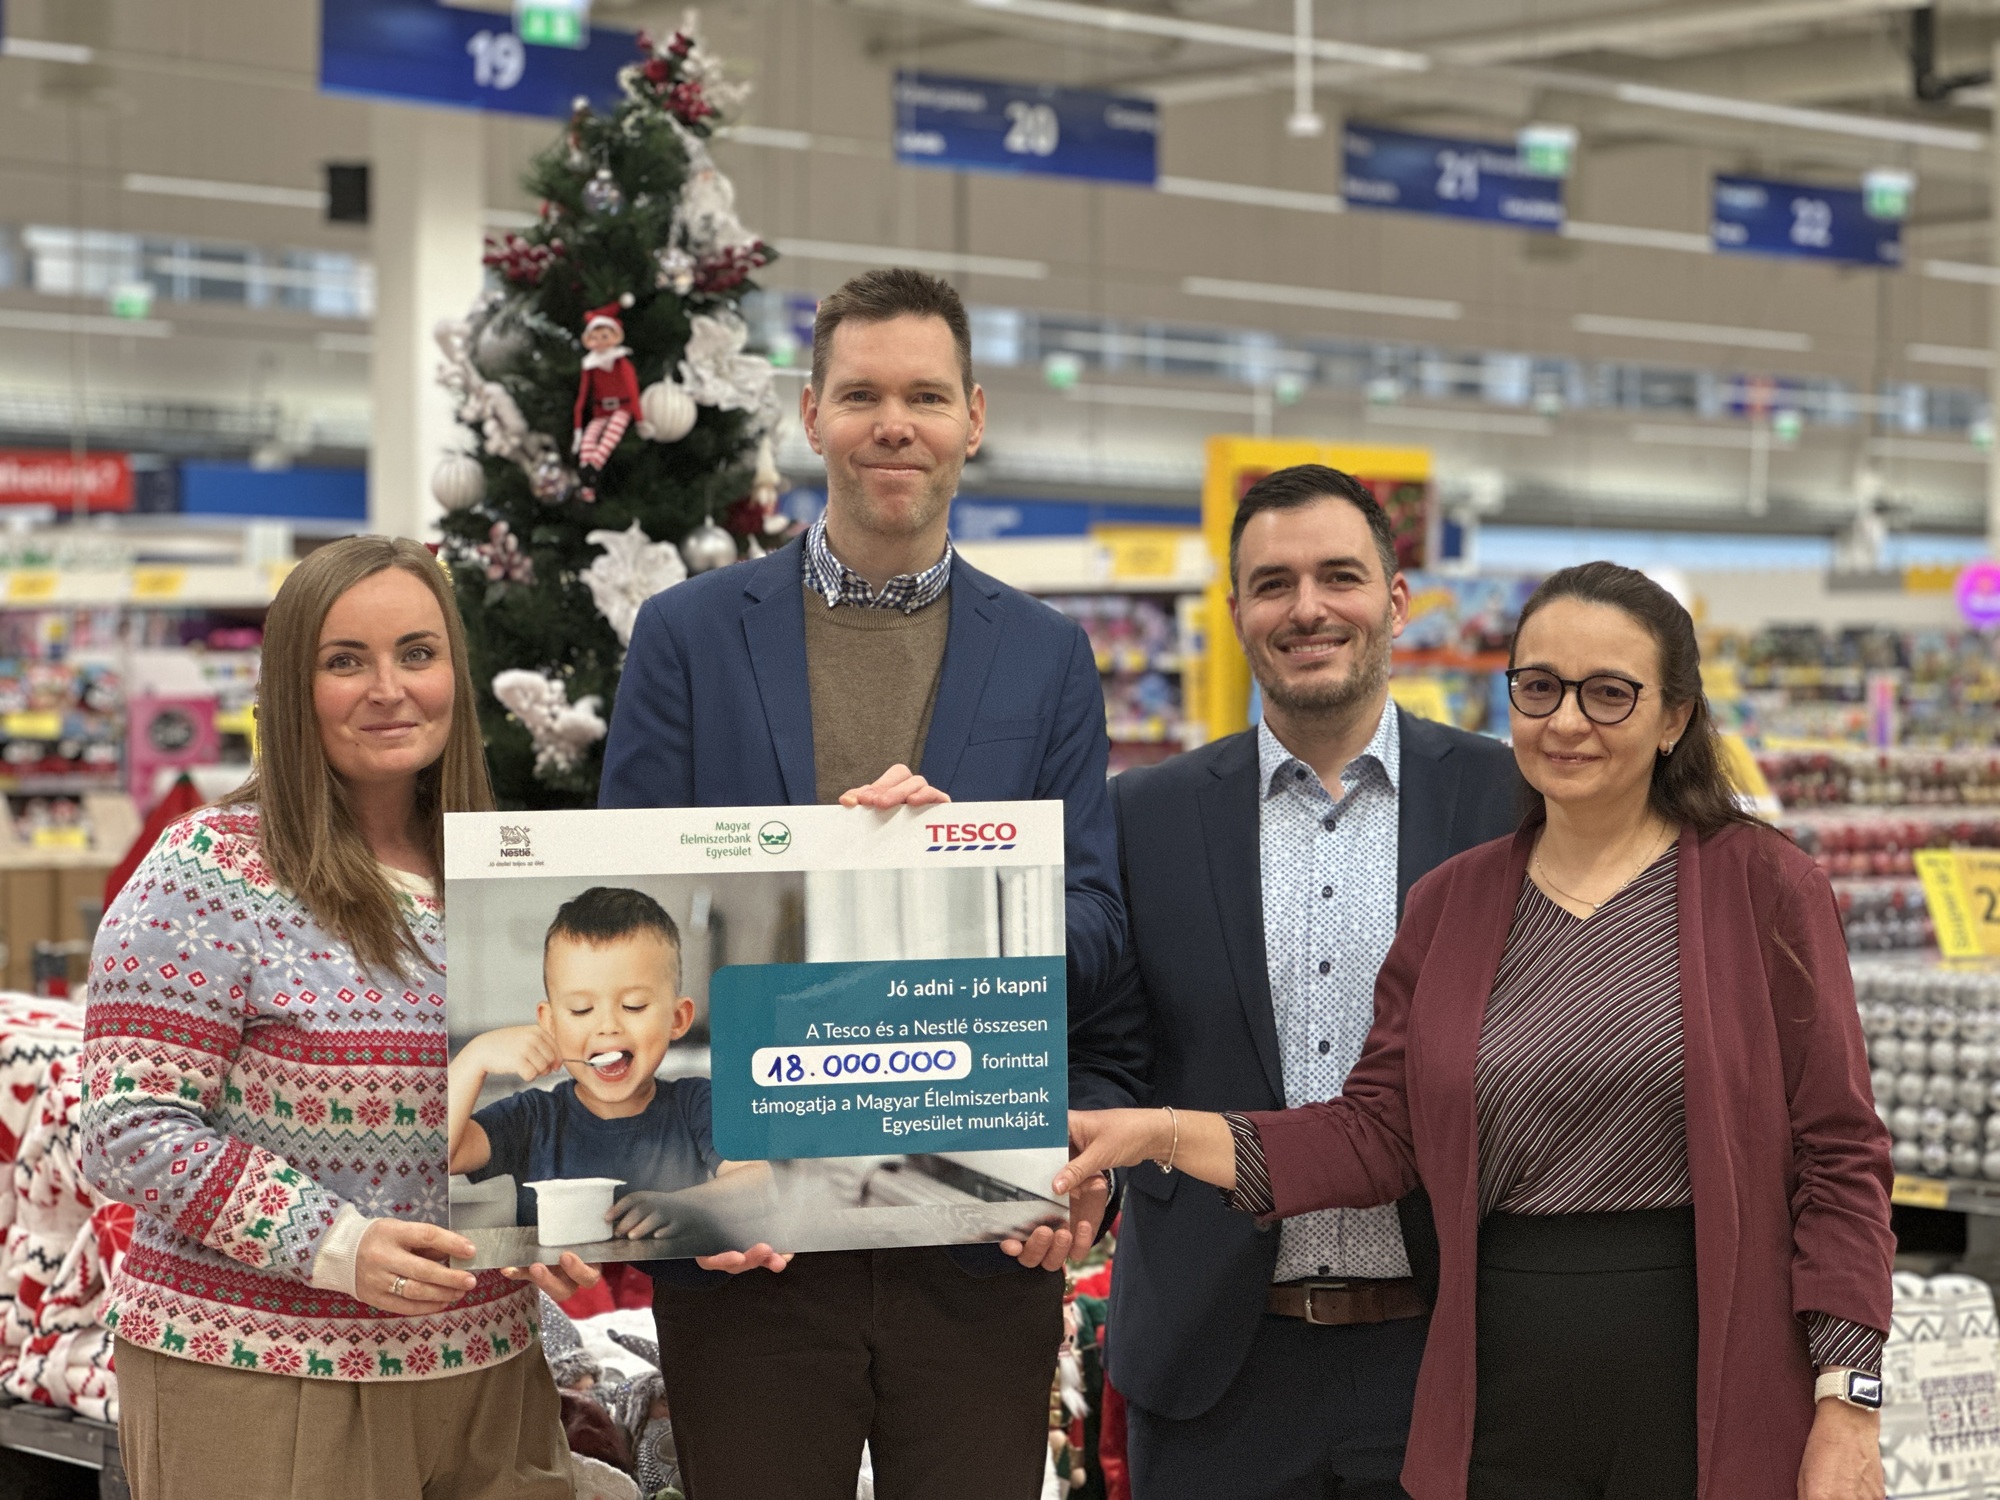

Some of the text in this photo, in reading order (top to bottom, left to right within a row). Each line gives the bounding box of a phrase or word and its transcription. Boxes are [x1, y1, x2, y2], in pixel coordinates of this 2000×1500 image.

[466, 29, 526, 90] 19
[1003, 100, 1059, 157] 20
[1436, 149, 1479, 201] 21
[1790, 197, 1833, 248] 22
[680, 832, 752, 845] Élelmiszerbank
[715, 822, 751, 833] Magyar
[925, 823, 1017, 842] TESCO
[500, 847, 531, 858] Nestlé
[706, 846, 752, 859] Egyesület
[887, 980, 907, 997] Jó
[914, 979, 954, 997] adni
[972, 978, 991, 998] jó
[996, 976, 1047, 997] kapni
[806, 1018, 1048, 1039] A Tesco és a Nestlé összesen
[767, 1049, 1049, 1083] 18.000.000 forinttal
[751, 1087, 1050, 1116] támogatja a Magyar Élelmiszerbank
[882, 1111, 1050, 1136] Egyesület munkáját.
